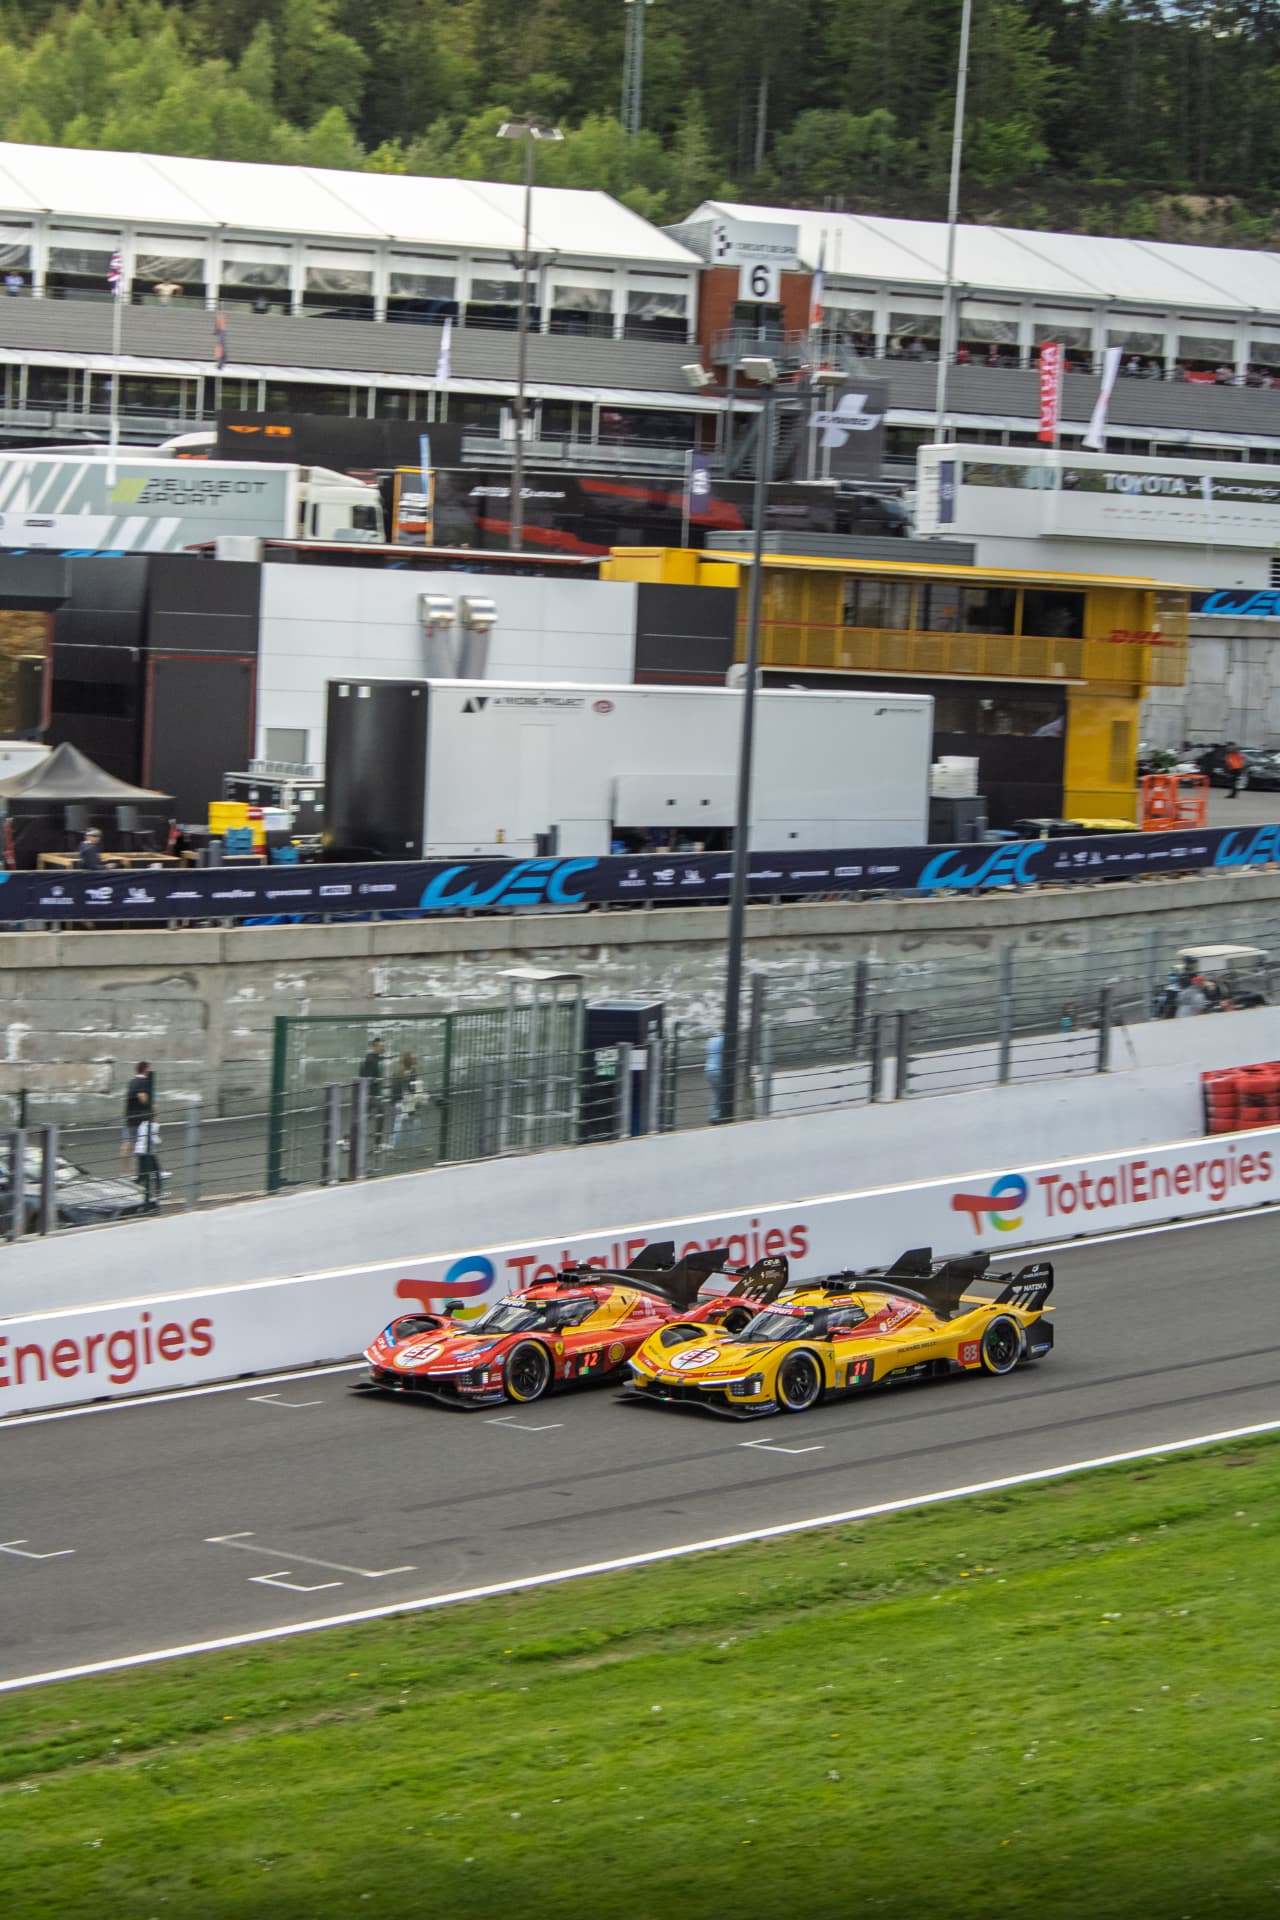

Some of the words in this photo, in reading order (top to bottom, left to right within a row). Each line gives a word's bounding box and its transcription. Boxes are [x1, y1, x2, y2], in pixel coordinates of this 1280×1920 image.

[751, 265, 770, 297] 6
[147, 478, 268, 494] PEUGEOT
[1103, 472, 1187, 495] TOYOTA
[137, 492, 223, 505] SPORT
[917, 841, 1046, 889] WEC
[420, 857, 598, 907] WEC
[1036, 1145, 1273, 1217] TotalEnergies
[583, 1352, 599, 1367] 12
[963, 1344, 977, 1361] 83
[854, 1361, 868, 1377] 11
